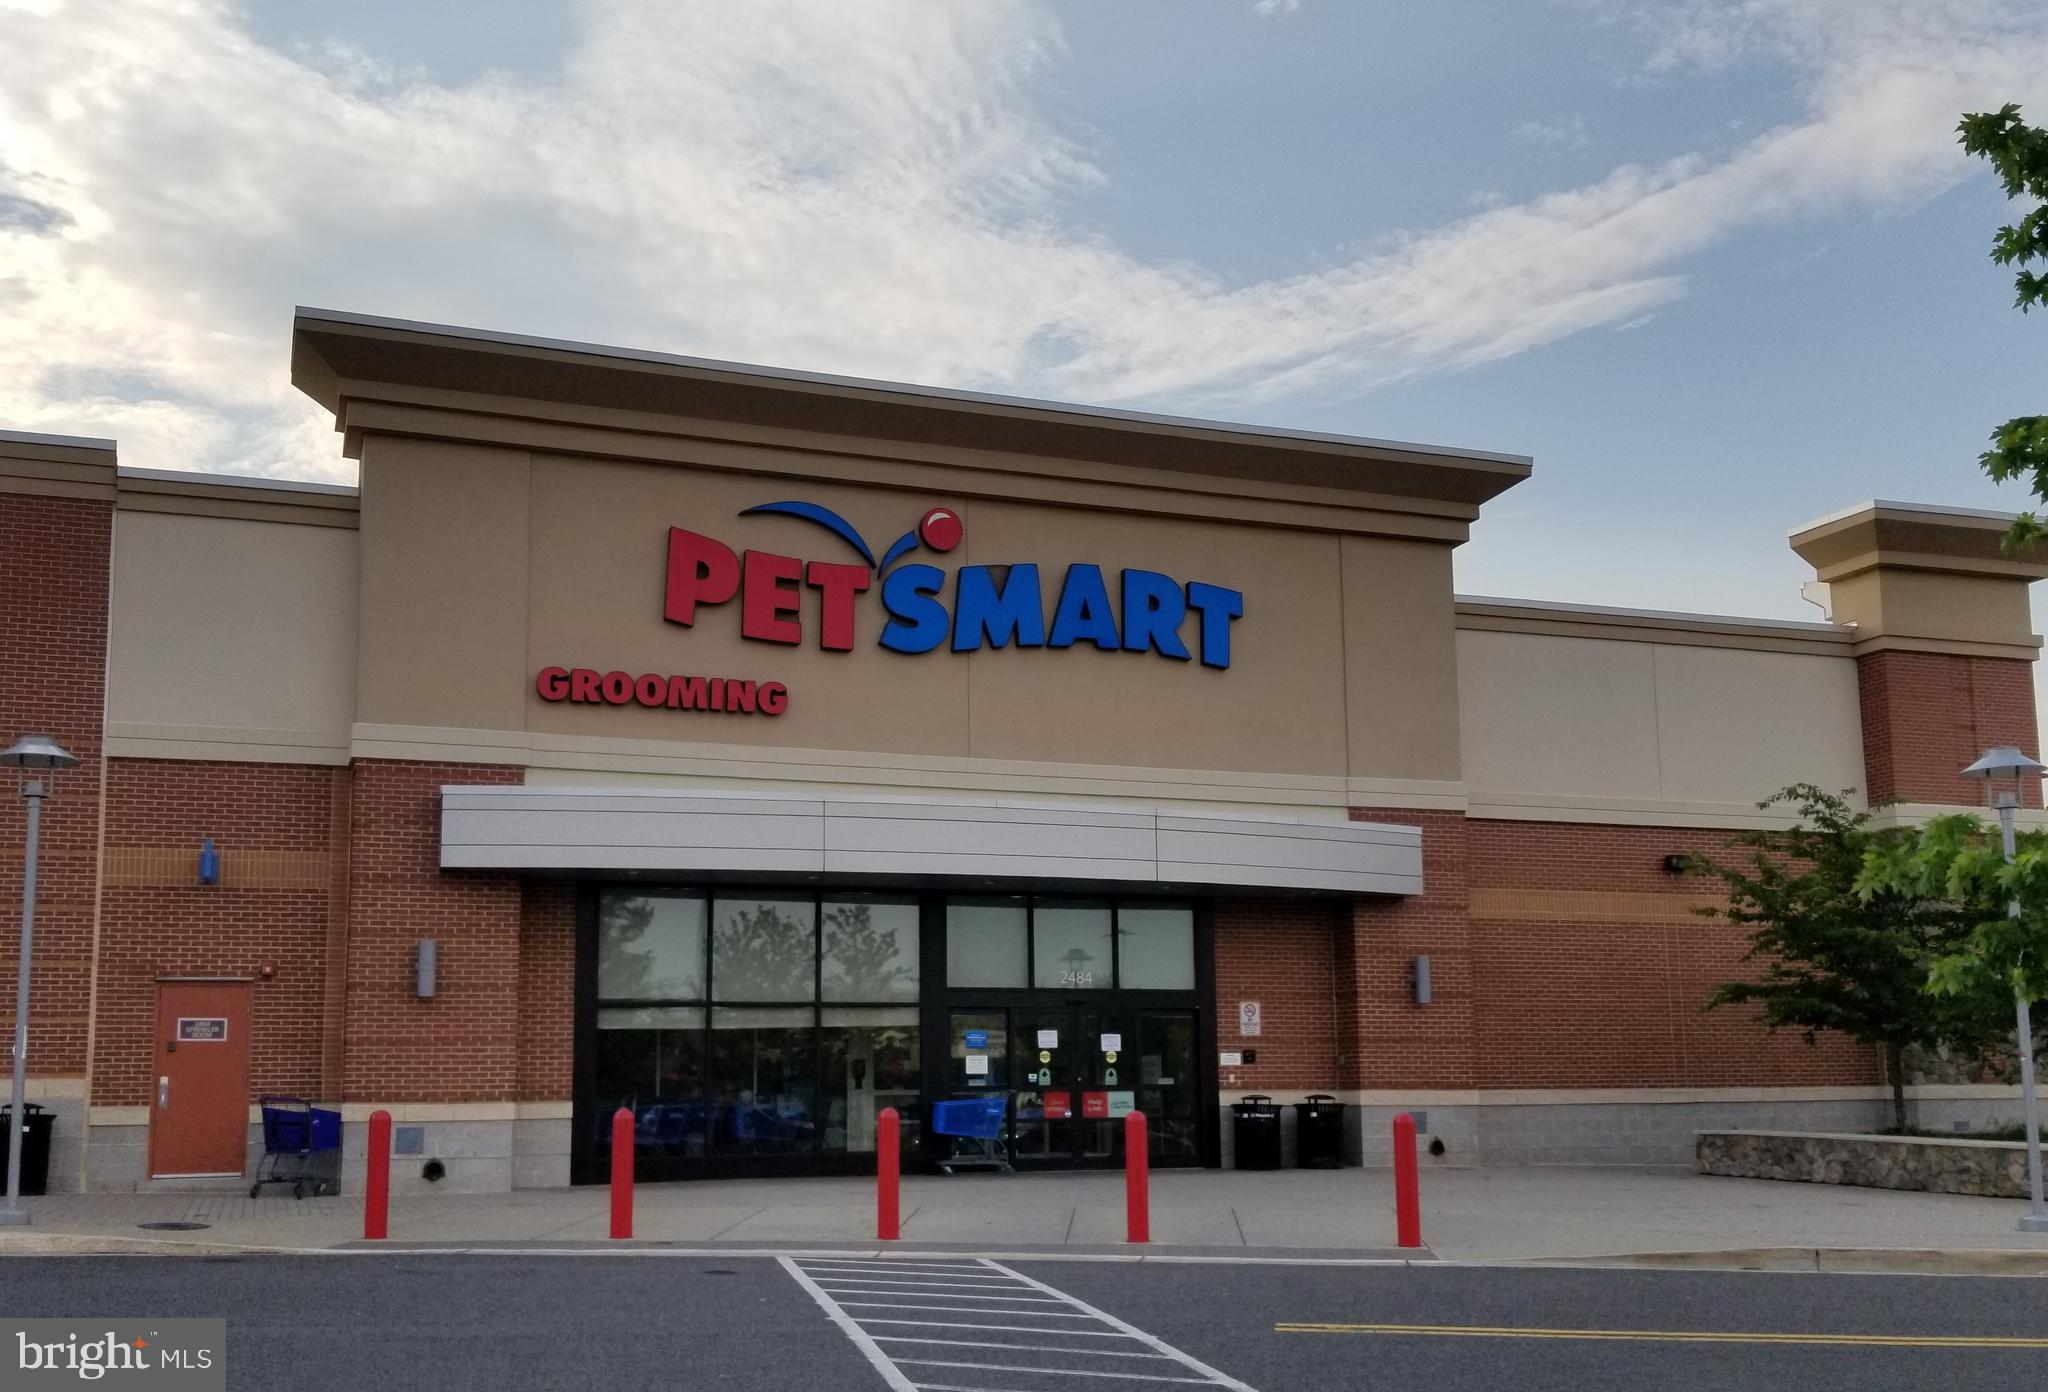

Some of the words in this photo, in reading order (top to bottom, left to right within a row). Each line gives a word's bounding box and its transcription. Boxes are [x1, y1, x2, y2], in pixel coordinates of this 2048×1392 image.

[663, 526, 1243, 669] PETSMART
[536, 666, 788, 715] GROOMING
[1060, 971, 1093, 984] 2484
